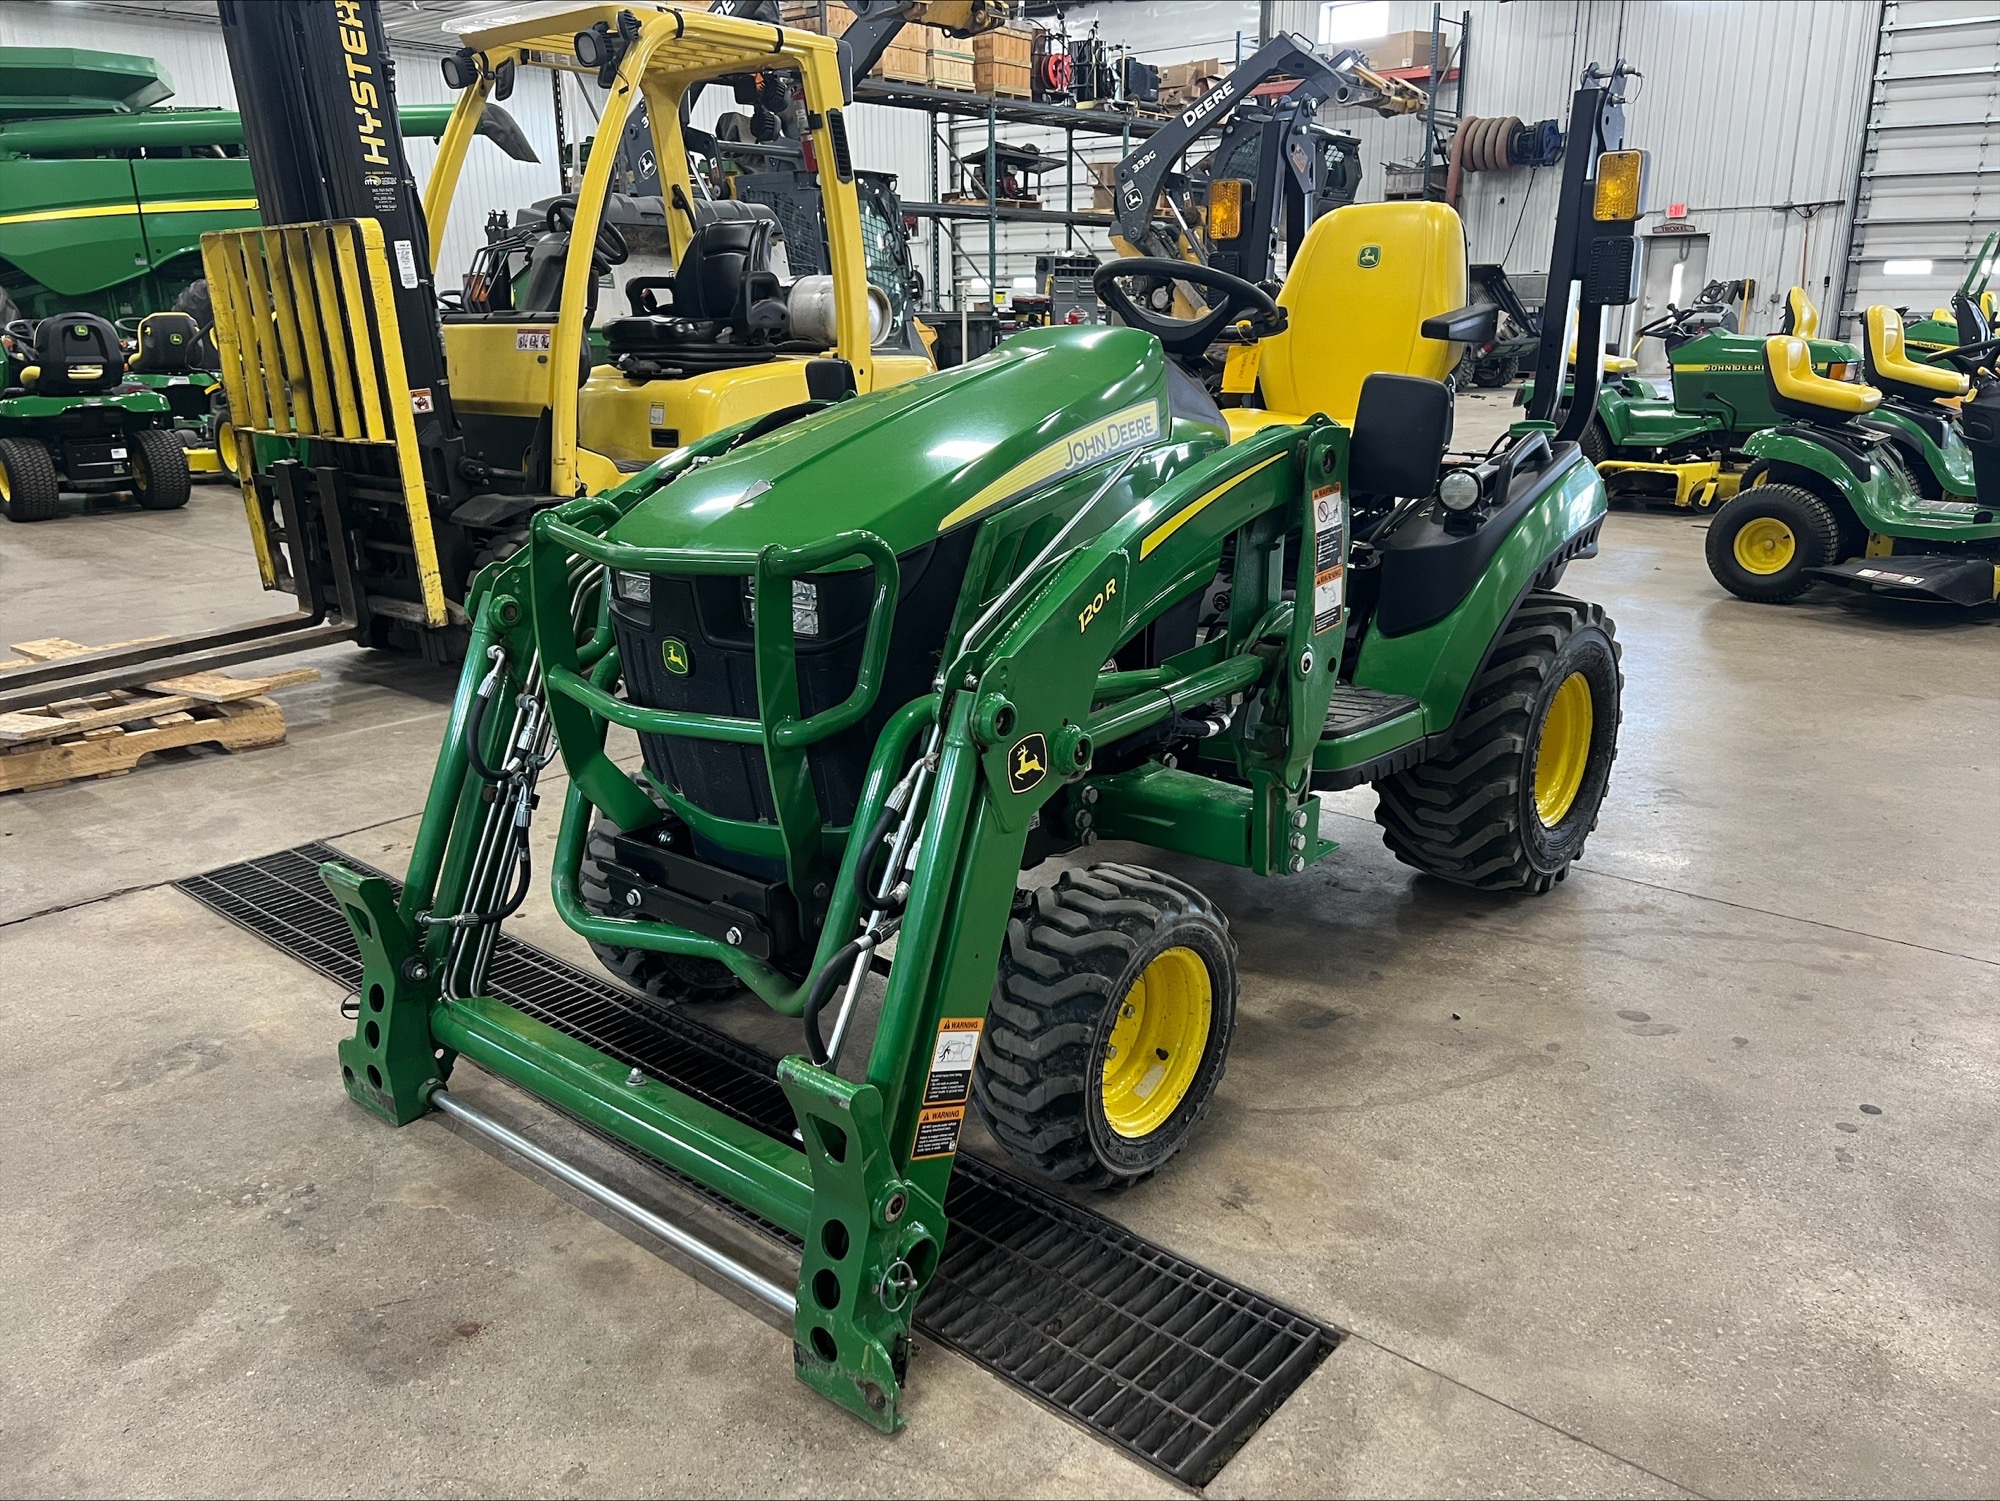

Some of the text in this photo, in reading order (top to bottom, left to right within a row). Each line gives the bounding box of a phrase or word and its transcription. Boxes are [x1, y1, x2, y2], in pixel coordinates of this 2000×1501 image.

[1182, 80, 1235, 128] DEERE
[1131, 150, 1157, 174] 333G
[1669, 204, 1685, 216] EXIT
[1065, 415, 1155, 469] JOHN DEERE
[1078, 578, 1117, 633] 120 R
[951, 1021, 979, 1029] WARNING
[931, 1110, 960, 1120] WARNING
